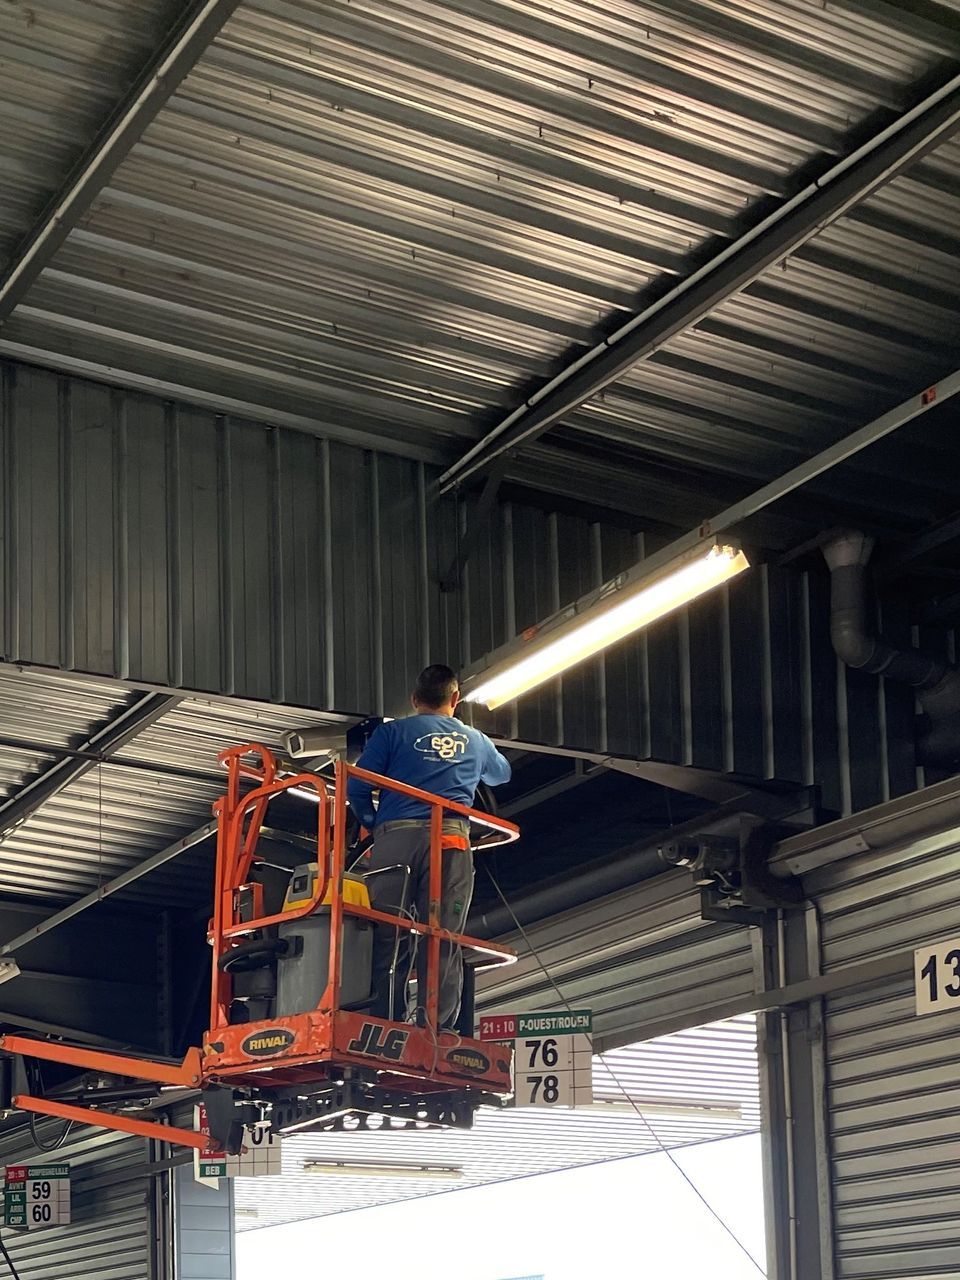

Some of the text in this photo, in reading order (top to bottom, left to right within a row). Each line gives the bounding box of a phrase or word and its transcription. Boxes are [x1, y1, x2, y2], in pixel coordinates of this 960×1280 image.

[249, 1035, 288, 1050] RIWAL
[347, 1023, 410, 1062] JLG
[453, 1054, 486, 1070] RIWAL
[525, 1038, 559, 1068] 76
[526, 1075, 559, 1104] 78
[32, 1181, 51, 1200] 59
[32, 1203, 51, 1223] 60
